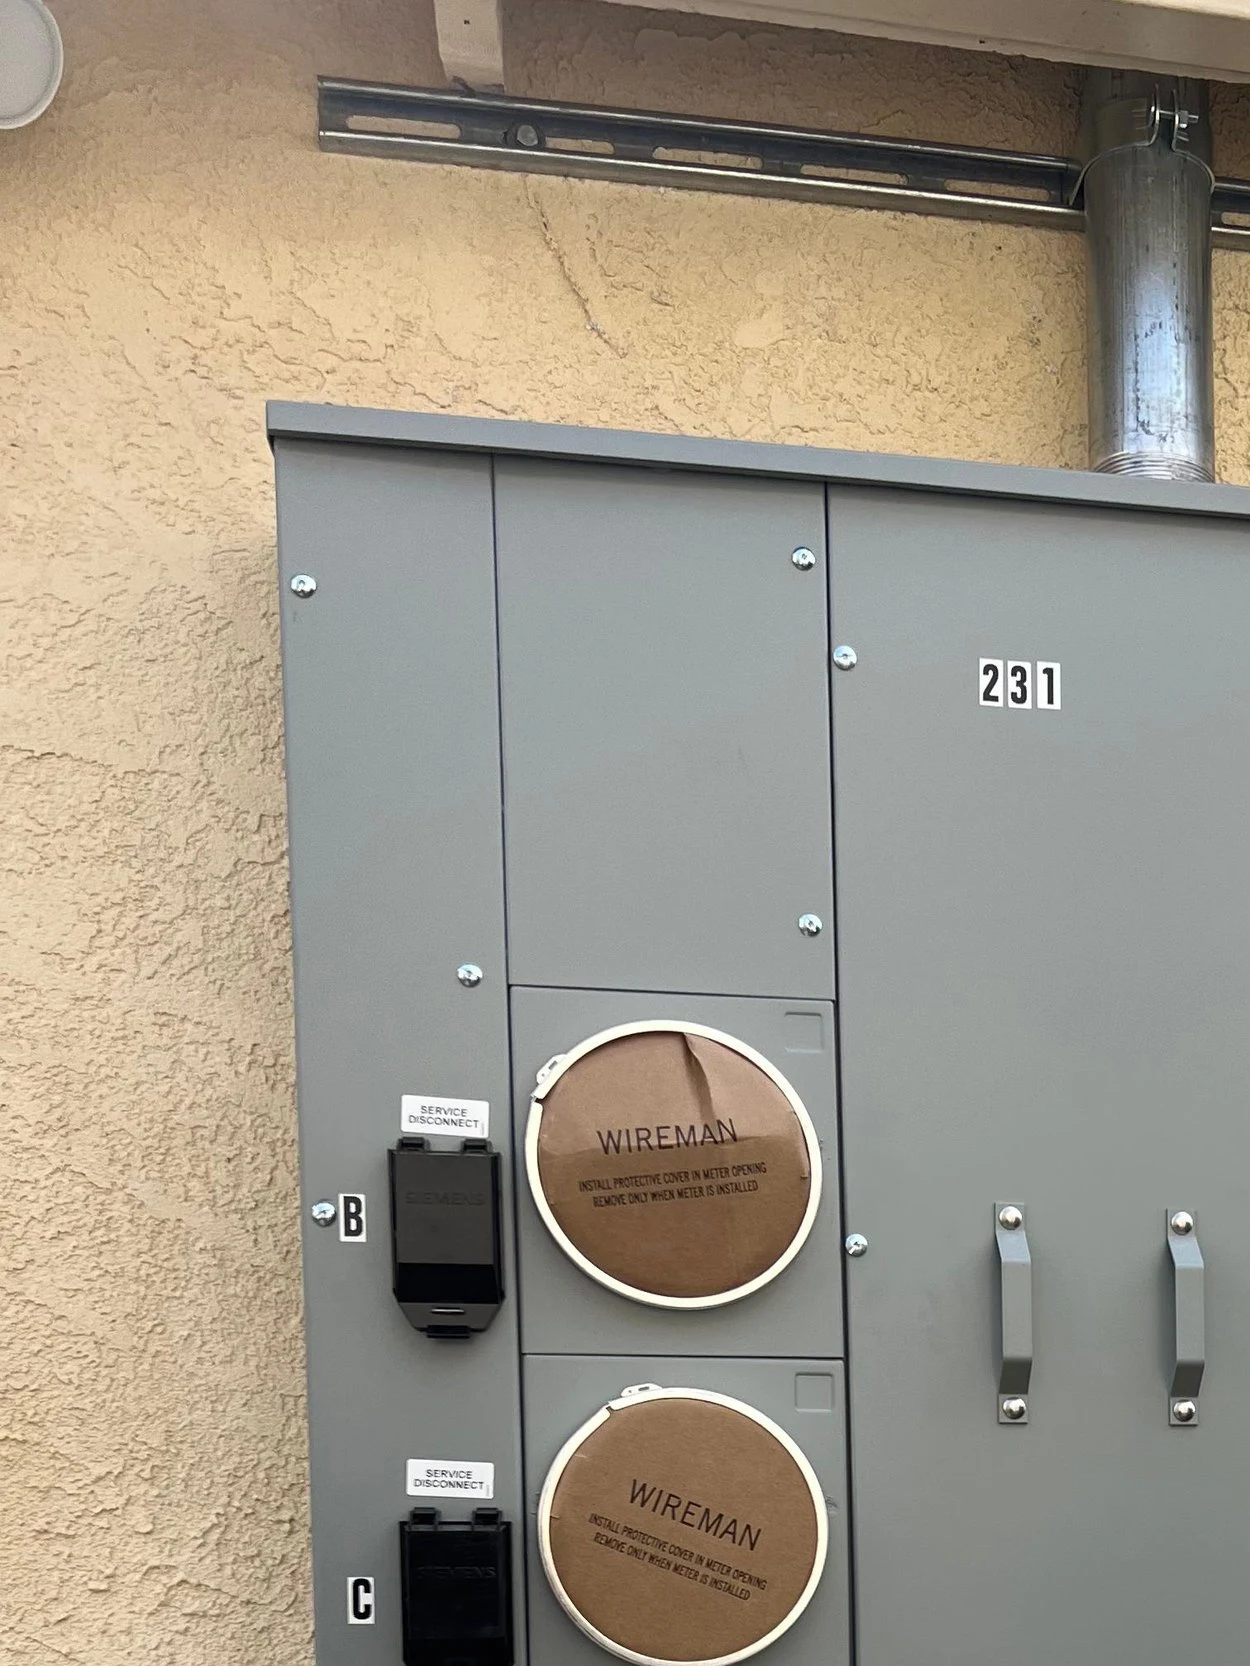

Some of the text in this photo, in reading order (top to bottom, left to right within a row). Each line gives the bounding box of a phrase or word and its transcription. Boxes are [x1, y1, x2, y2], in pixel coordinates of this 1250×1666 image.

[983, 664, 1054, 705] 231
[408, 1115, 479, 1128] DISCONNECT
[421, 1105, 468, 1117] SERVICE
[597, 1118, 738, 1155] WIREMAN
[579, 1162, 766, 1192] INSTALL PROTECTIVE COVER IN METER OPENING
[593, 1180, 758, 1208] REMOVE ONLY WHEN METER IS INSTALLED
[343, 1196, 363, 1236] B
[414, 1479, 484, 1489] DISCONNECT
[426, 1469, 473, 1479] SERVICE
[629, 1479, 762, 1551] WIREMAN
[588, 1513, 767, 1590] INSTALL PROTECTIVE COVER IN METER OPENING
[594, 1532, 750, 1600] REMOVE ONLY WHEN METER IS INSTALLED
[352, 1578, 372, 1620] C
